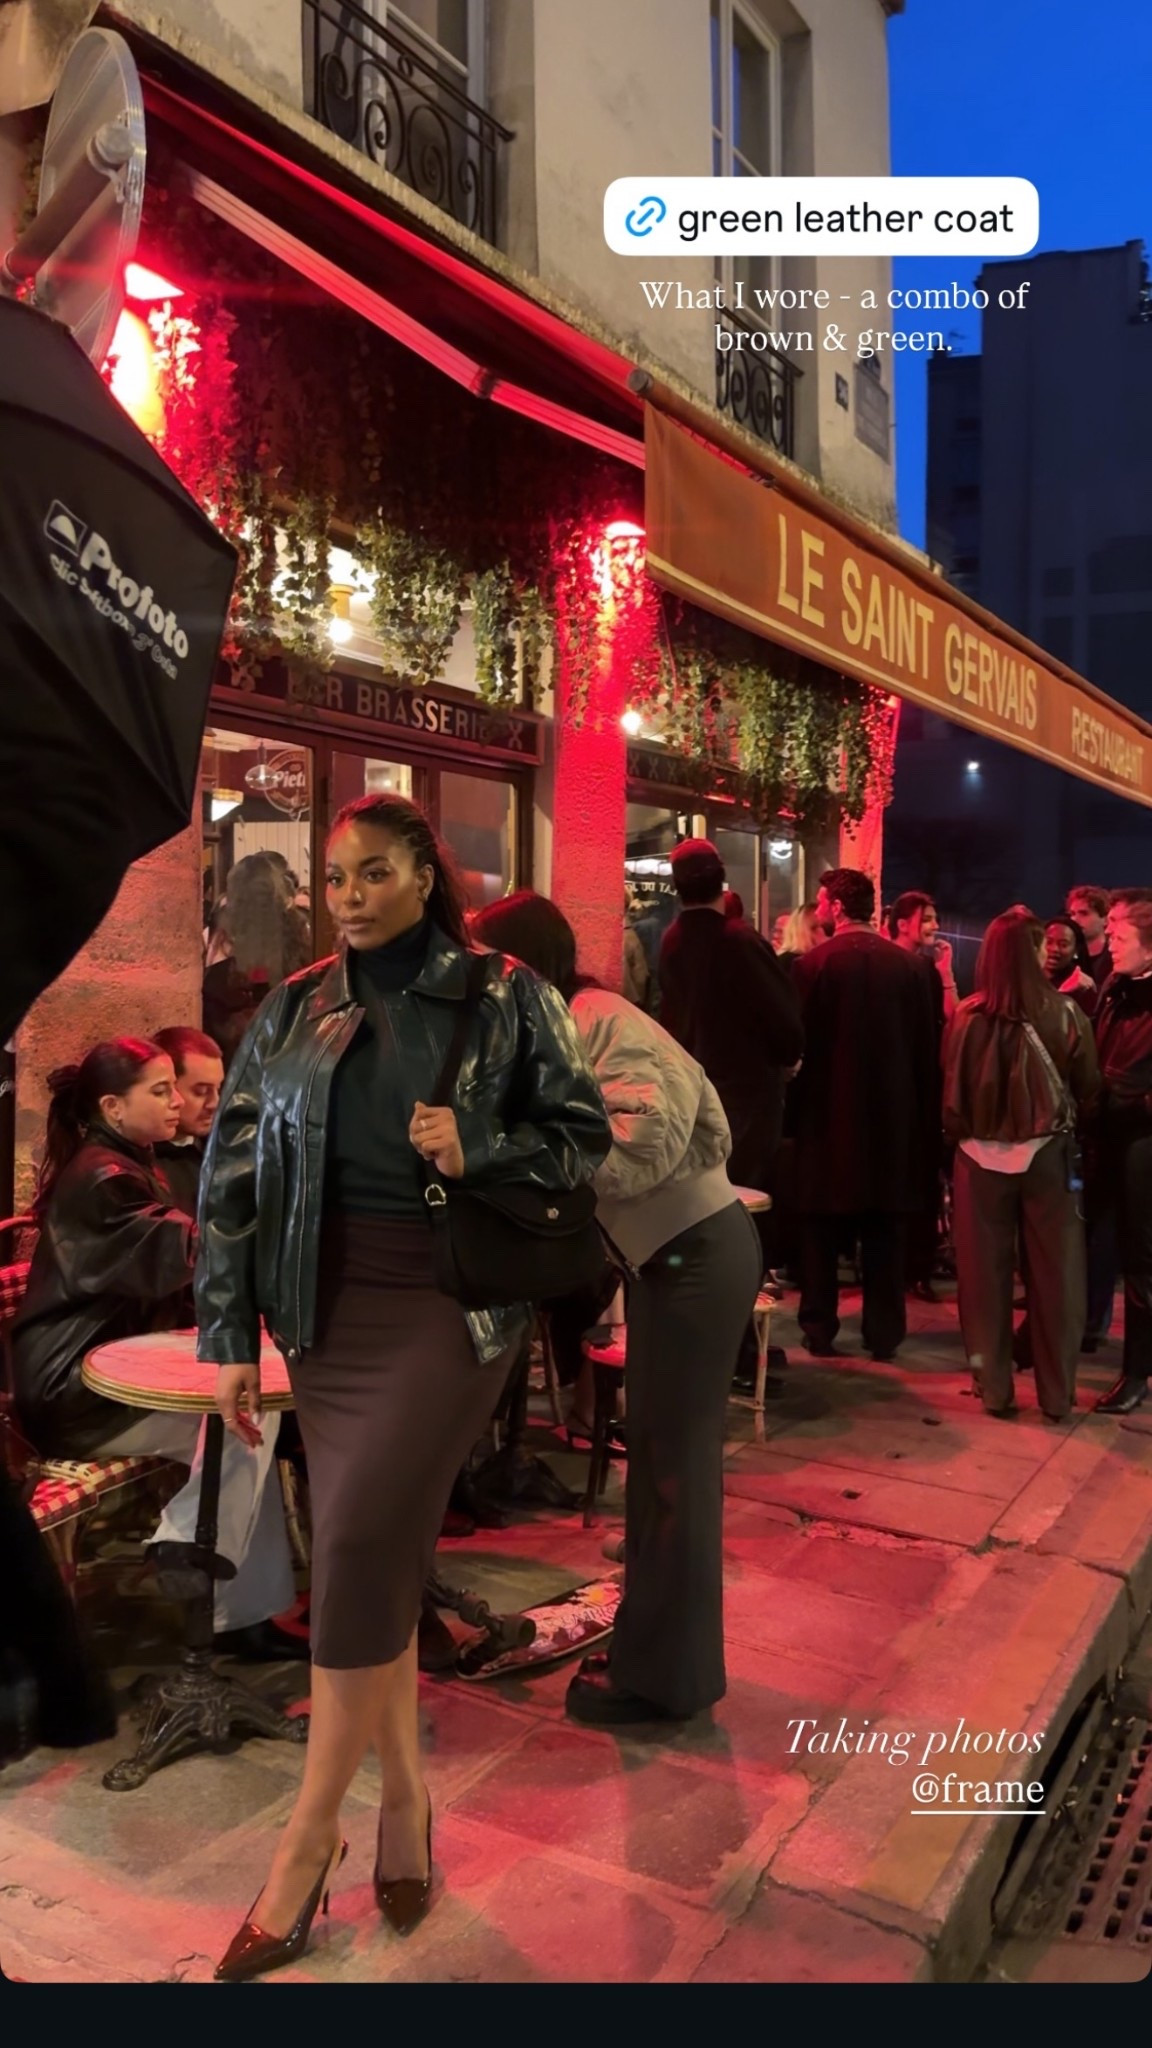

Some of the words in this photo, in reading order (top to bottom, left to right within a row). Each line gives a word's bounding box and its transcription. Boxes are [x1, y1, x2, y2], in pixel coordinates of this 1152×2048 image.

[80, 532, 189, 659] Profoto
[777, 513, 825, 628] LE
[841, 558, 934, 680] SAINT
[944, 623, 1037, 731] GERVAIS
[288, 672, 343, 711] BR
